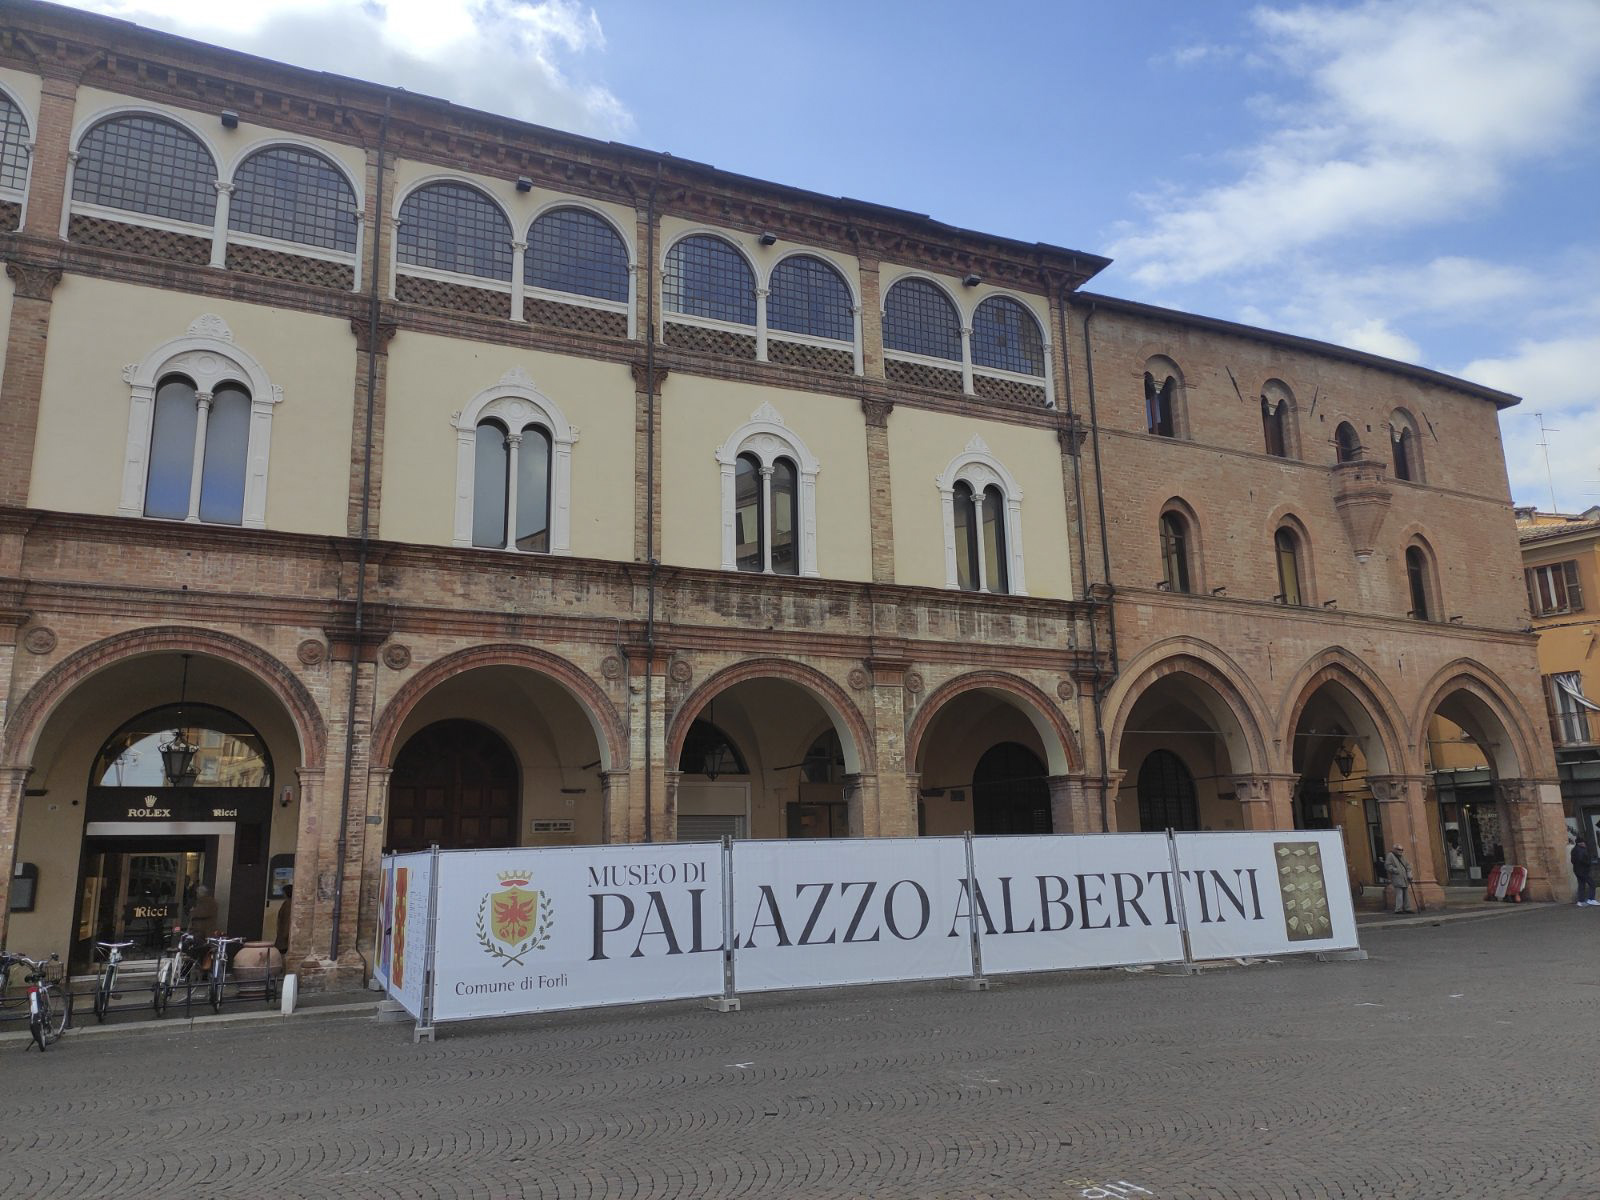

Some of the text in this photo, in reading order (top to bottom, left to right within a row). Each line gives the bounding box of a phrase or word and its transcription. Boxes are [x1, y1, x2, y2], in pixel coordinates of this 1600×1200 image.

[128, 808, 171, 818] ROLEX
[588, 861, 706, 888] MUSEO DI
[588, 868, 1265, 961] PALAZZO ALBERTINI
[455, 981, 515, 996] Comune
[520, 976, 533, 990] di
